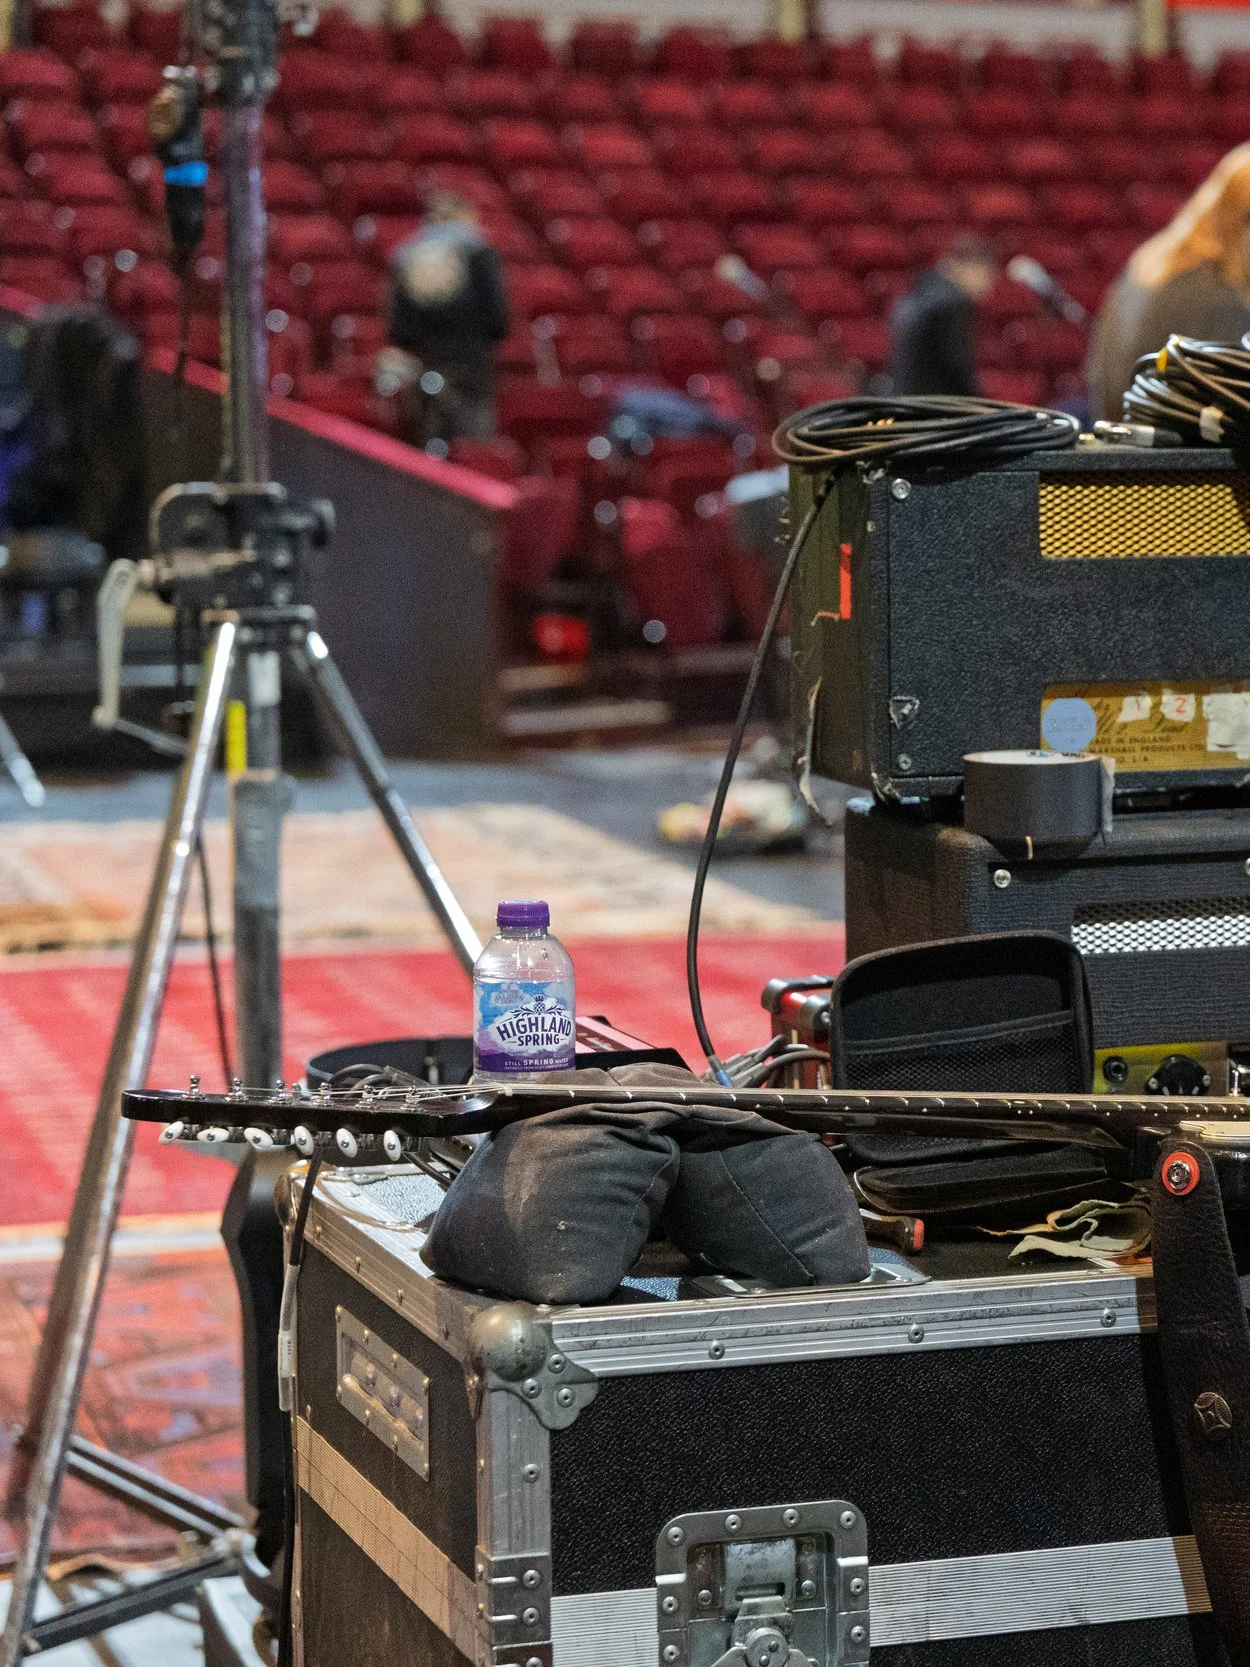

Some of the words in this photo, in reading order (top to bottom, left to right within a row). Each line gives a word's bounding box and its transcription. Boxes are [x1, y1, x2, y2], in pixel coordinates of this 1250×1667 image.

[1174, 696, 1187, 713] 2
[1129, 735, 1172, 744] ENGLAND
[1140, 744, 1186, 752] PRODUCTS
[496, 1016, 572, 1041] HIGHLAND
[518, 1033, 560, 1047] SPRING
[523, 1058, 554, 1066] SPRING
